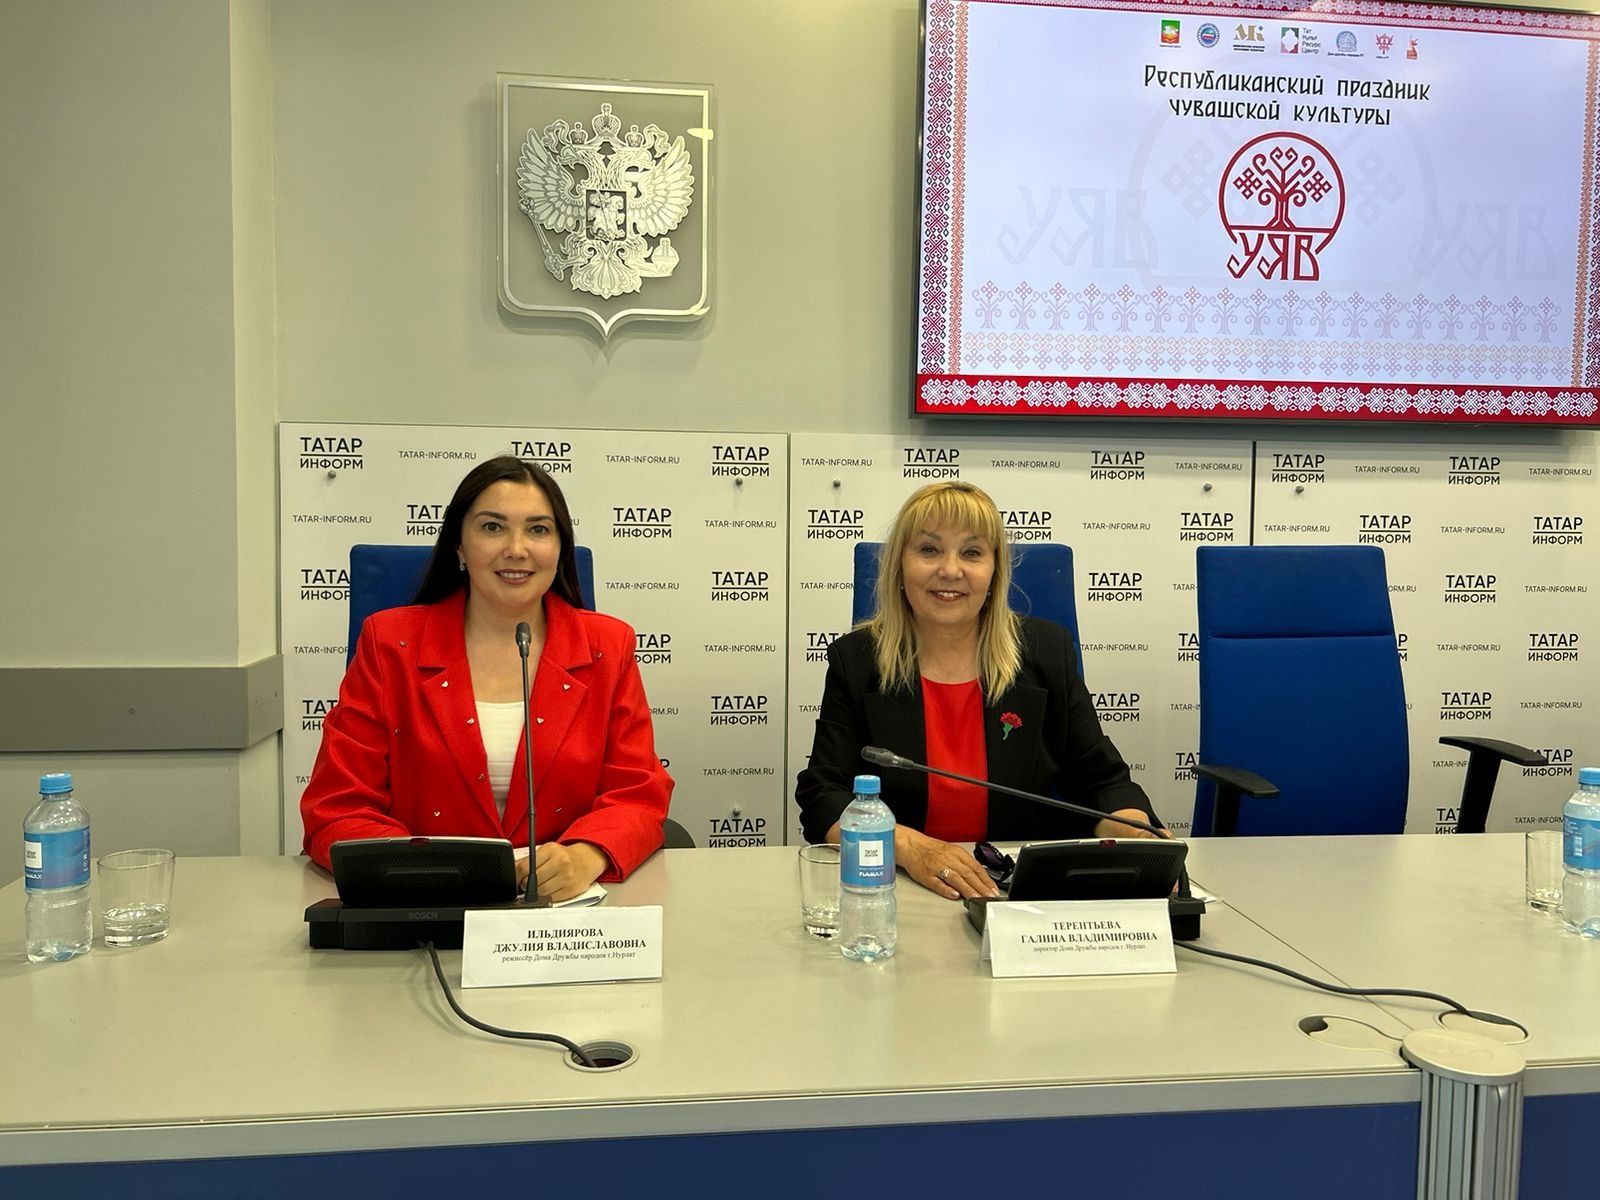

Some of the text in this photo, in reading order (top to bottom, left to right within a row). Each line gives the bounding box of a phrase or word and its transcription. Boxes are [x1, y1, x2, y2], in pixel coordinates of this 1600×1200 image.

[1144, 65, 1431, 100] Республиканский праздник
[1169, 98, 1391, 125] чувашской культуры
[1227, 232, 1319, 281] УЯВ
[300, 437, 362, 452] ТАТАР
[511, 442, 571, 458] ТАТАР
[399, 451, 476, 459] TATAR-INFORM.RU
[606, 455, 680, 464] TATAR-INFORM.RU
[713, 446, 769, 461] ТАТАР
[904, 449, 959, 463] ТАТАР
[1091, 451, 1144, 465] ТАТАР
[300, 458, 363, 469] ИНФОРМ
[992, 460, 1060, 468] TATAR-INFORM.RU
[1273, 454, 1325, 468] ТАТАР
[1449, 456, 1500, 470] ТАТАР
[540, 462, 572, 473] ОРМ
[712, 464, 769, 476] ИНФОРМ
[904, 466, 959, 478] ИНФОРМ
[1091, 468, 1144, 480] ИНФОРМ
[1272, 471, 1324, 483] ИНФОРМ
[1449, 476, 1500, 485] ИНФОРМ
[407, 504, 450, 520] ТАТ
[613, 508, 671, 522] ТАТАР
[808, 510, 863, 523] ТАТАР
[999, 512, 1051, 524] ТАТАР
[293, 515, 371, 523] TATAR-INFORM.RU
[705, 520, 776, 528] TATAR-INFORM.RU
[1181, 513, 1233, 526] ТАТАР
[1360, 515, 1411, 528] ТАТАР
[1534, 517, 1582, 530] ТАТАР
[407, 526, 441, 536] ИНФ
[613, 528, 671, 538] ИНФОРМ
[808, 527, 863, 539] ИНФОРМ
[1006, 531, 1051, 540] НФОРМ
[1180, 532, 1233, 541] ИНФОРМ
[1359, 534, 1411, 543] ИНФОРМ
[1533, 533, 1582, 544] ИНФОРМ
[301, 570, 350, 584] ТАТА
[712, 572, 768, 585] ТАТАР
[1089, 573, 1142, 586] ТАТАР
[1446, 575, 1496, 588] ТАТАР
[301, 590, 350, 600] ИНФОР
[712, 592, 768, 601] ИНФОРМ
[1088, 592, 1142, 601] ИНФОРМ
[1445, 594, 1495, 603] ИНФОРМ
[636, 634, 671, 648] ТАР
[807, 633, 838, 646] ТАТ
[1530, 634, 1578, 647] ТАТАР
[294, 646, 348, 654] TATAR-INFO
[1082, 644, 1148, 652] TATAR-INFORM.RU
[1528, 652, 1577, 661] ИНФОРМ
[711, 696, 767, 710] ТАТАР
[1442, 692, 1491, 705] ТАТАР
[302, 700, 338, 714] ТАТ
[711, 713, 767, 725] ИНФОРМ
[1441, 711, 1491, 720] ИНФОРМ
[1543, 749, 1573, 762] ТАР
[1522, 768, 1572, 776] ИНФОРМ
[710, 818, 766, 833] ТАТАР
[708, 839, 766, 848] ИНФОРМ
[1051, 921, 1121, 930] ТЕРЕНТЬЕВА
[527, 928, 604, 940] ИЛЬДИЯРОВА
[1021, 932, 1158, 944] ГАЛИНА ВЛАДИМИРОВНА
[493, 939, 647, 954] ДЖУЛИЯ ВЛАДИСЛАВОВНА
[552, 953, 579, 962] Дружбы
